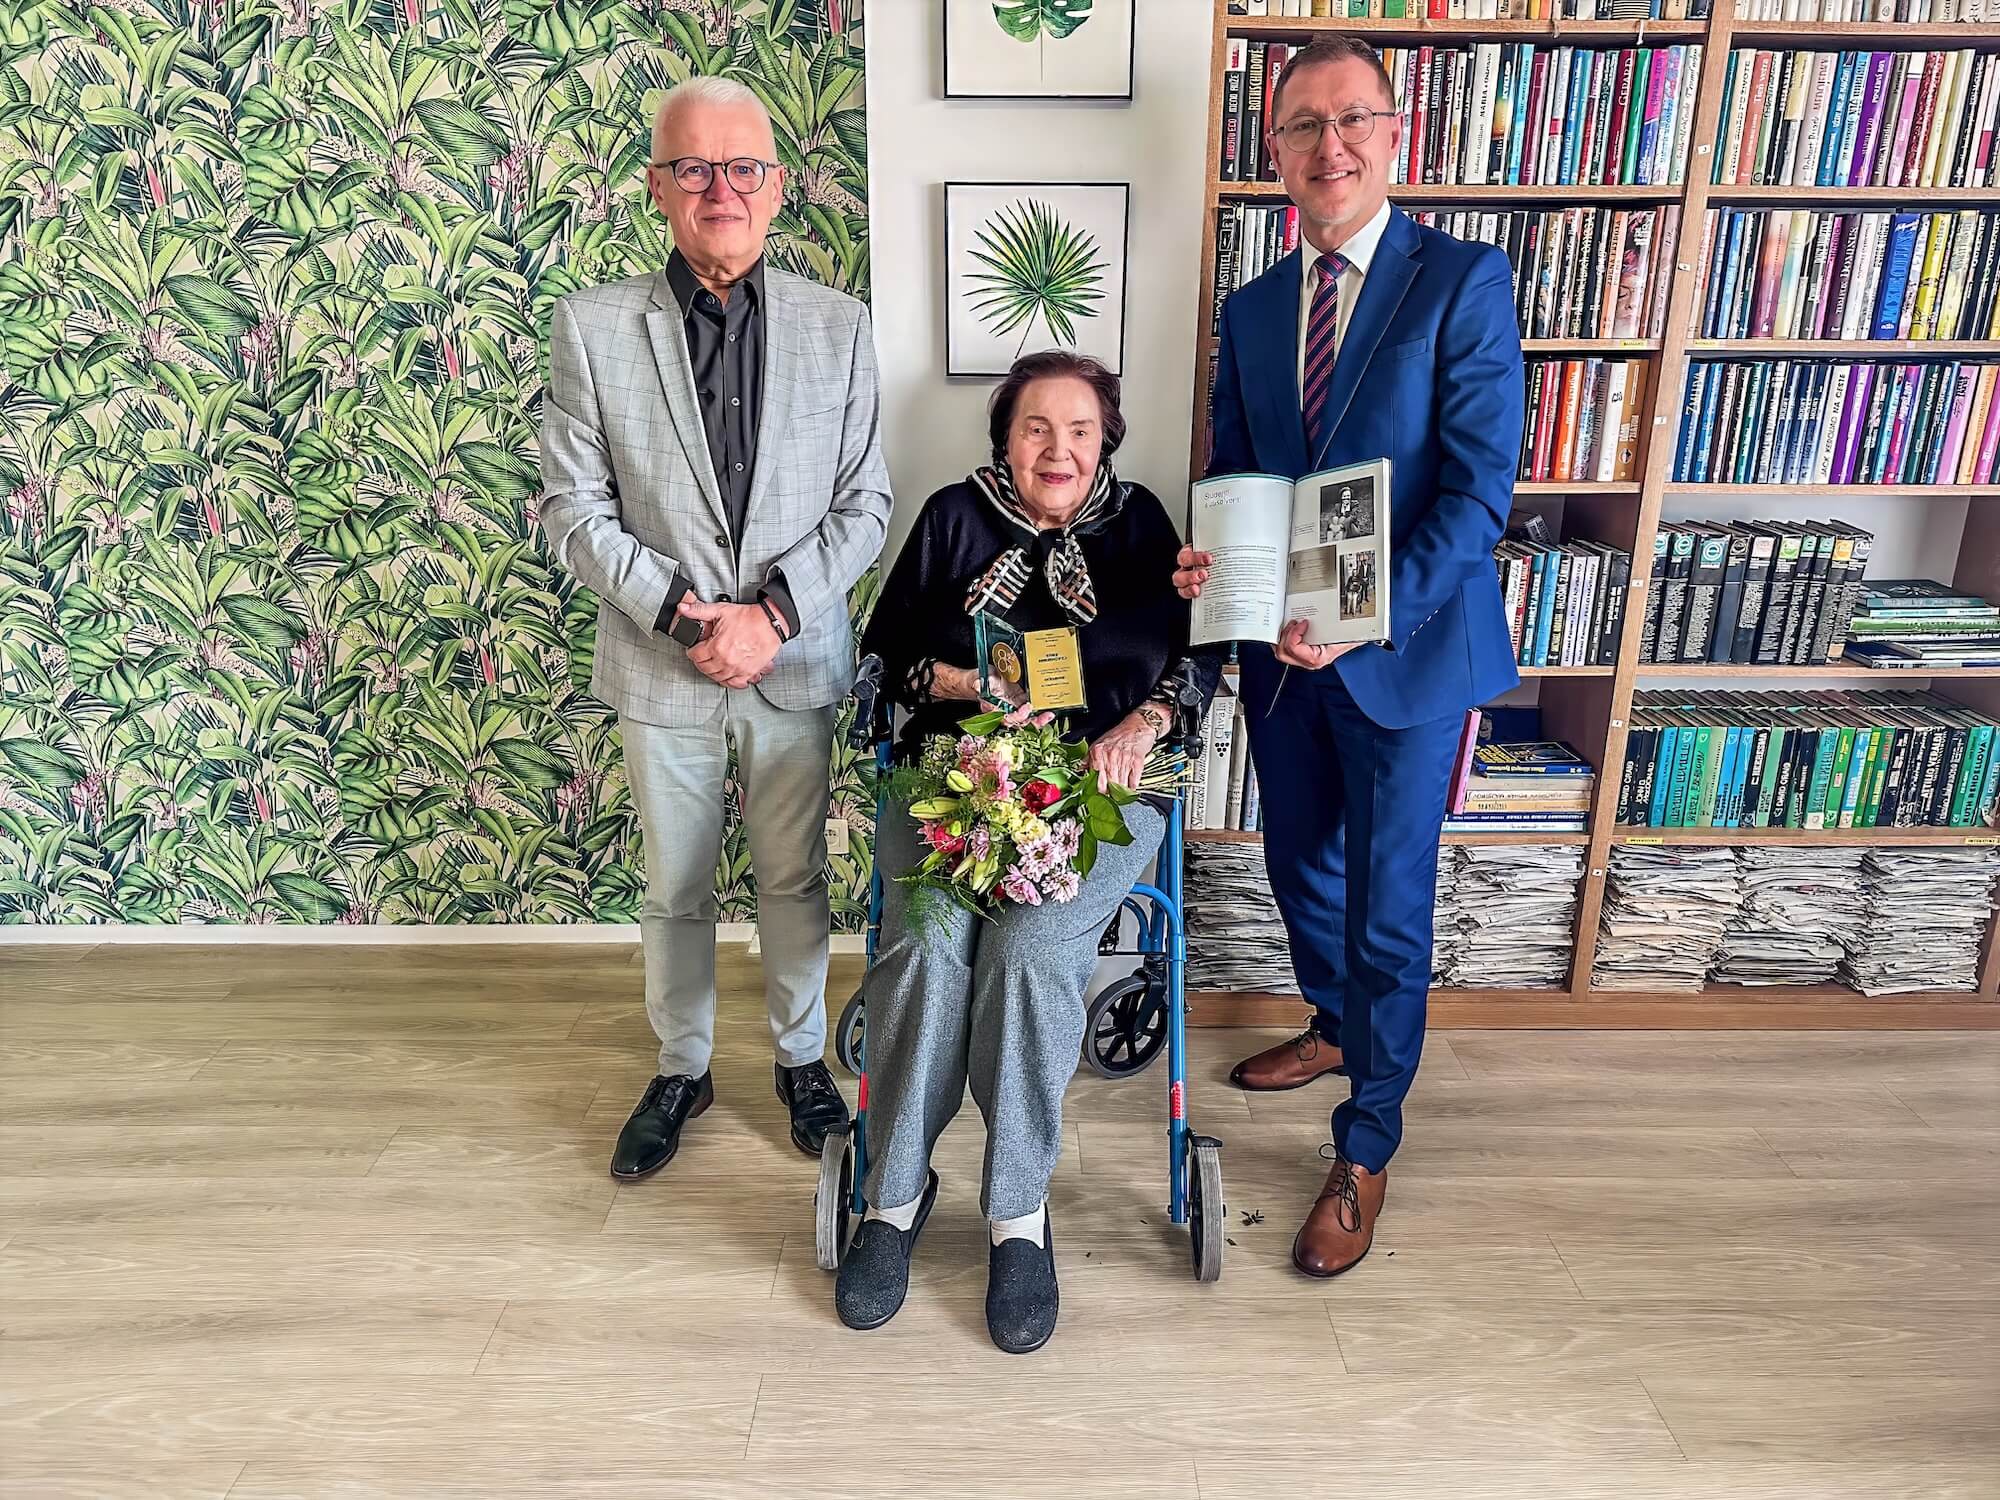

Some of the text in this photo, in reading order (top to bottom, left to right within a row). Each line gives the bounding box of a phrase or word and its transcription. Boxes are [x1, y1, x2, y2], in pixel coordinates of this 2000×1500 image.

[1248, 49, 1263, 111] ROTHSCHILDOVÉ
[1227, 118, 1237, 131] ECO
[1216, 252, 1231, 288] MSTITEL
[1840, 227, 1858, 278] DOMINUS
[1820, 457, 1828, 476] JACK
[1213, 702, 1226, 739] Chvála
[1927, 733, 1942, 767] VERALDI
[1621, 761, 1634, 805] DAVID CRAIG
[1635, 786, 1644, 804] JOHN
[1776, 762, 1790, 807] DAVID CRAIG
[1963, 801, 1972, 822] RUTH
